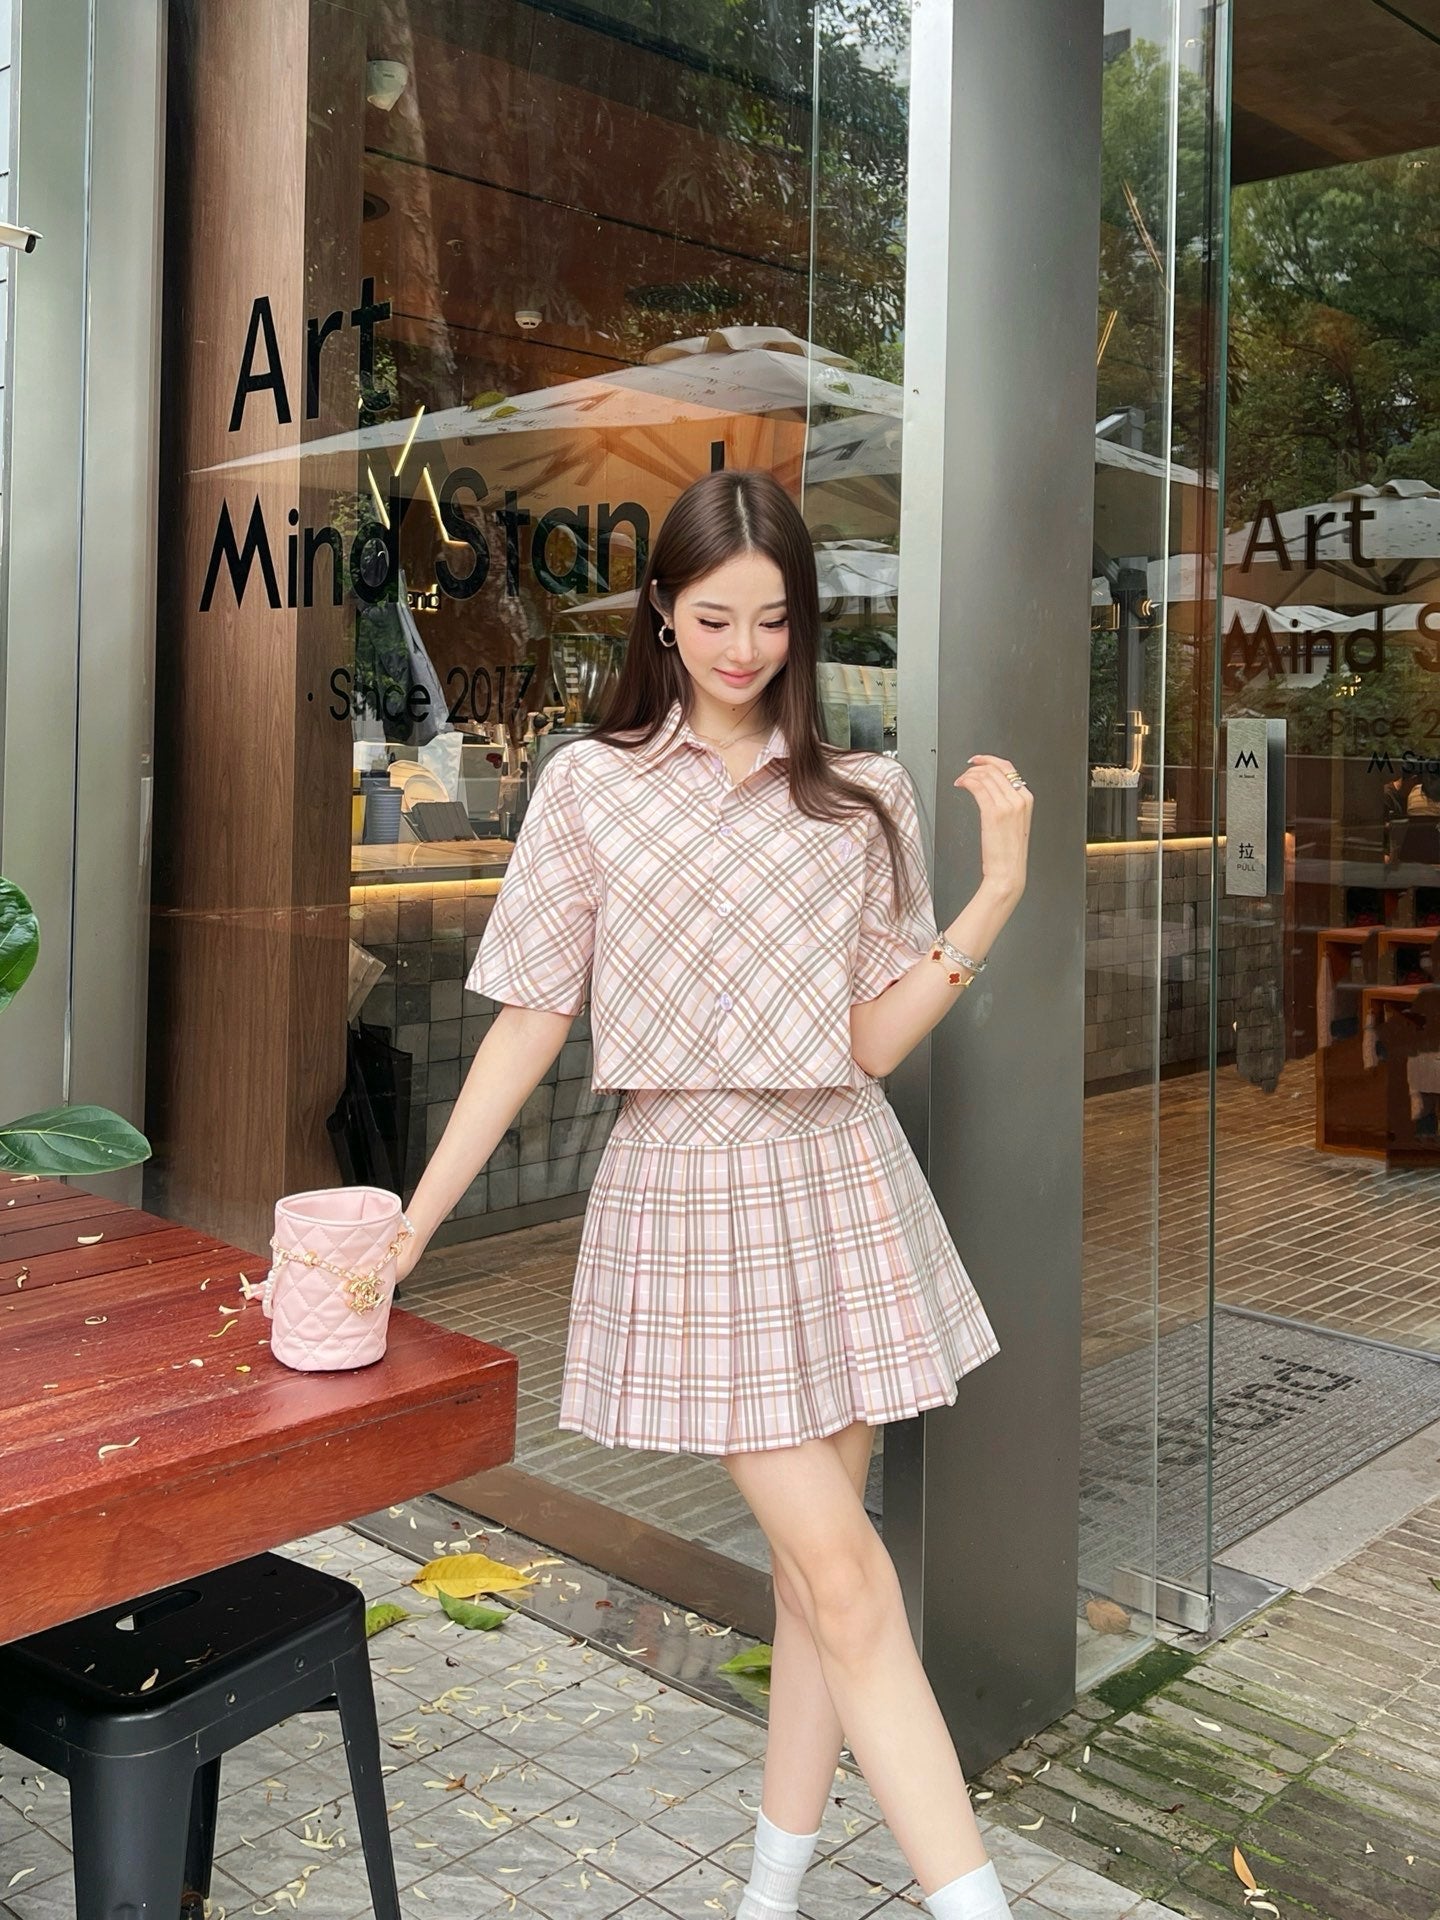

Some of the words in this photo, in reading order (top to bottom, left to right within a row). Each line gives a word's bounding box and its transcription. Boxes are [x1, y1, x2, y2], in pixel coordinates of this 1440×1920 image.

[228, 277, 392, 433] Art
[199, 475, 399, 612] Mind
[434, 441, 725, 600] Stan
[1240, 495, 1376, 573] Art
[1224, 606, 1384, 677] Mind
[329, 667, 432, 724] Since
[446, 664, 537, 724] 2017
[1327, 708, 1411, 738] Since
[1234, 750, 1259, 769] M
[1366, 751, 1394, 774] M
[1236, 863, 1256, 872] PULL
[1238, 842, 1255, 860] 拉
